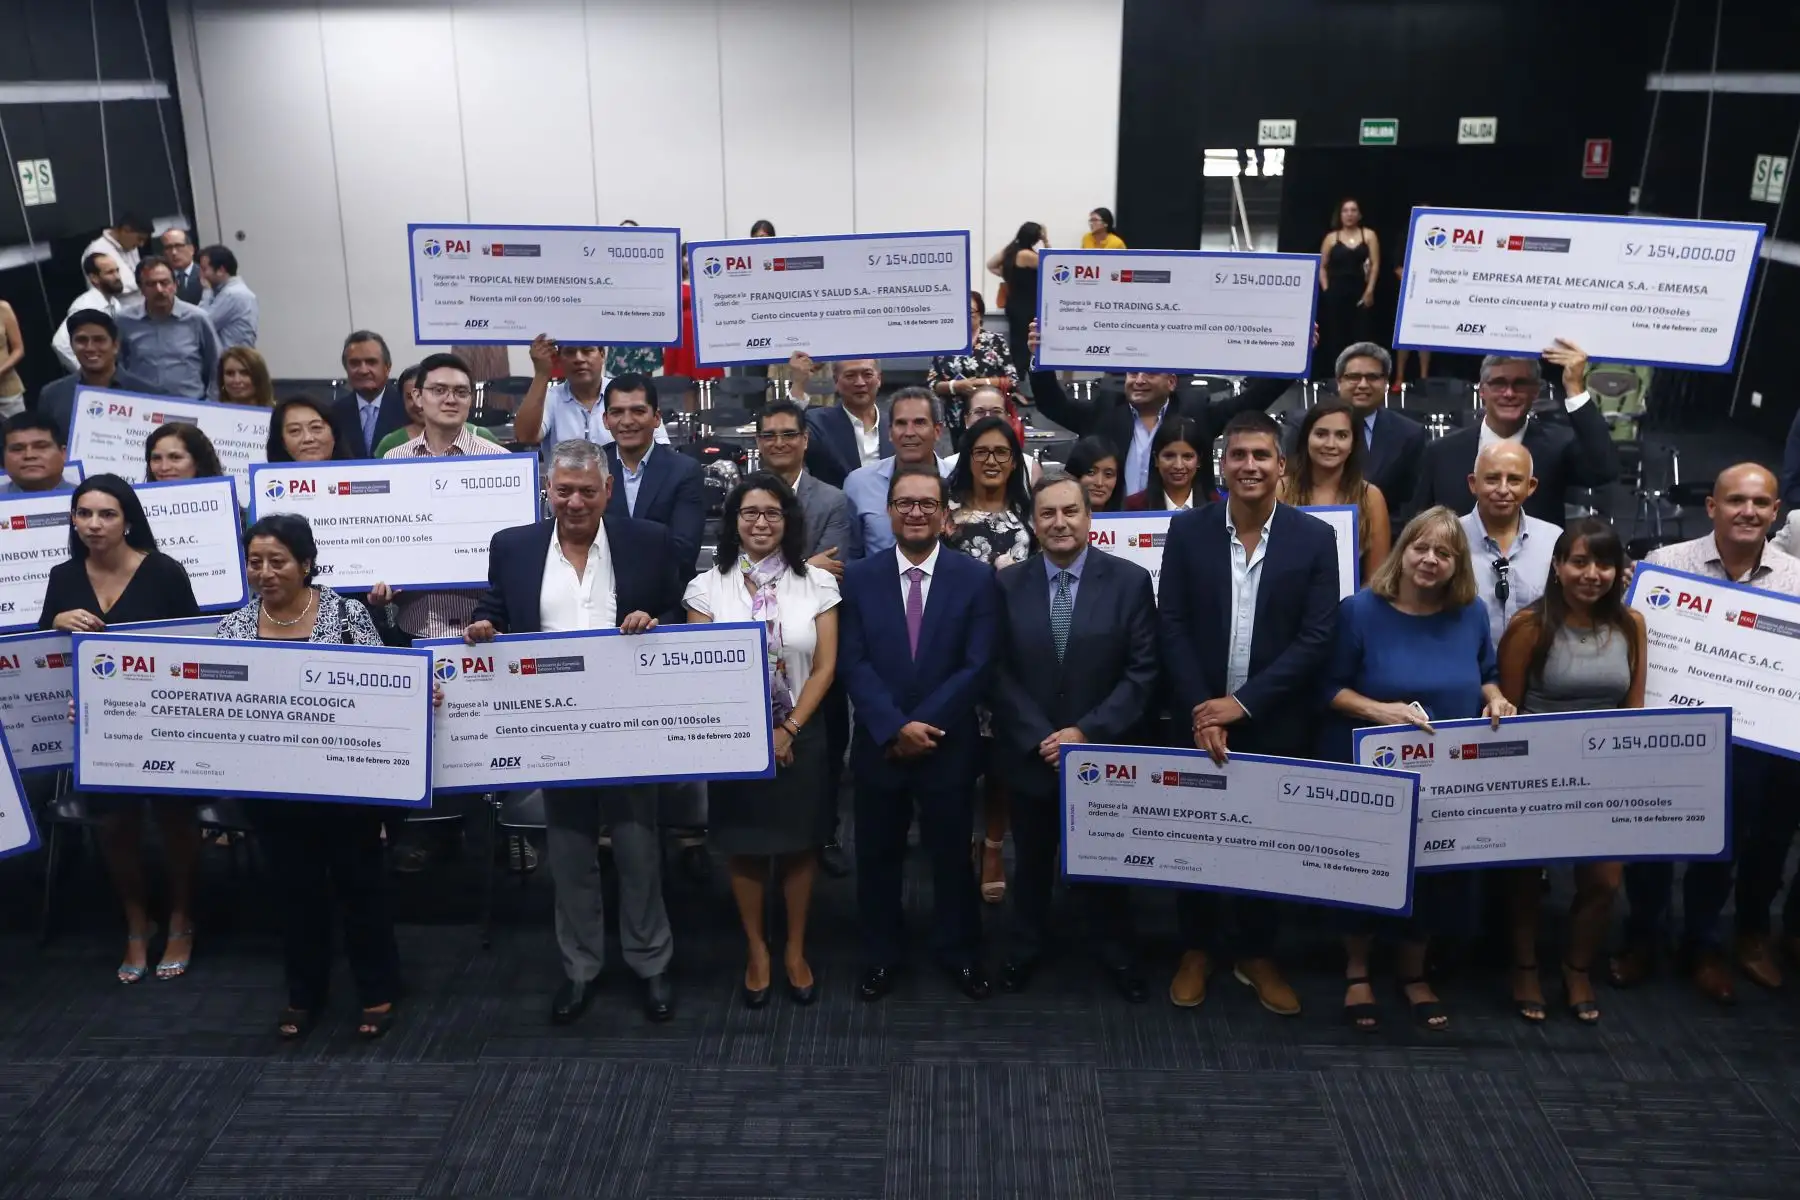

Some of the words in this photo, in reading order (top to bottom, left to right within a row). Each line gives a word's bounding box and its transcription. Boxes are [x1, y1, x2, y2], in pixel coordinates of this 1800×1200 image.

[1262, 125, 1291, 139] SALIDA
[1462, 123, 1492, 138] SALIDA
[39, 163, 50, 186] S
[1452, 228, 1484, 245] PAI
[445, 240, 471, 253] PAI
[583, 246, 596, 257] S/
[1625, 243, 1643, 256] S/
[726, 256, 752, 270] PAI
[868, 255, 881, 266] S/
[1075, 266, 1100, 279] PAI
[1215, 273, 1228, 284] S/
[469, 275, 512, 284] TROPICAL
[514, 276, 535, 284] NEW
[536, 277, 587, 285] DIMENSION
[588, 277, 613, 286] S.A.C.
[1472, 272, 1523, 284] EMPRESA
[1525, 274, 1562, 286] METAL
[1564, 276, 1624, 289] MECANICA
[1628, 281, 1648, 291] S.A.
[1657, 283, 1708, 295] EMEMSA
[750, 290, 812, 301] FRANQUICIAS
[813, 289, 820, 298] Y
[821, 288, 852, 297] SALUD
[853, 287, 871, 296] S.A.
[877, 284, 932, 295] FRANSALUD
[934, 284, 951, 293] S.A.
[1094, 301, 1112, 310] FLO
[1113, 302, 1154, 311] TRADING
[1155, 302, 1181, 311] S.A.C.
[1468, 294, 1499, 304] Ciento
[1501, 296, 1549, 307] cincuenta
[1550, 301, 1556, 309] y
[1558, 301, 1590, 310] cuatro
[1591, 302, 1608, 311] mil
[1610, 304, 1628, 313] con
[465, 319, 490, 328] ADEX
[1456, 323, 1486, 334] ADEX
[746, 338, 771, 347] ADEX
[1086, 345, 1110, 354] ADEX
[108, 404, 133, 417] PAI
[289, 479, 316, 493] PAI
[435, 479, 448, 490] S/
[313, 516, 337, 526] NIKO
[339, 514, 413, 525] INTERNATIONAL
[415, 513, 433, 523] SAC
[315, 537, 349, 546] Noventa
[350, 536, 365, 545] mil
[382, 535, 411, 544] 00/100
[412, 534, 433, 542] soles
[1088, 531, 1115, 545] PAI
[316, 565, 335, 574] DEX
[1676, 591, 1713, 614] PAI
[640, 653, 656, 667] S/
[1694, 641, 1748, 663] BLAMAC
[1748, 654, 1784, 672] S.A.C.
[121, 655, 155, 673] PAI
[461, 656, 494, 673] PAI
[305, 669, 322, 684] S/
[1687, 665, 1733, 684] Noventa
[1735, 677, 1754, 689] mil
[1755, 683, 1775, 695] con
[151, 689, 232, 702] COOPERATIVA
[235, 693, 287, 705] AGRARIA
[290, 695, 356, 708] ECOLOGICA
[493, 699, 542, 711] UNILENE
[544, 697, 577, 708] S.A.C.
[31, 713, 65, 723] Ciento
[103, 708, 125, 716] orden
[151, 704, 224, 718] CAFETALERA
[227, 708, 243, 718] DE
[246, 709, 284, 720] LONYA
[286, 711, 336, 723] GRANDE
[495, 724, 528, 735] Ciento
[530, 722, 579, 733] cincuenta
[581, 723, 587, 732] y
[589, 720, 621, 730] cuatro
[623, 718, 639, 728] mil
[641, 718, 659, 727] con
[661, 714, 721, 726] 00/100soles
[114, 733, 133, 741] suma
[134, 733, 143, 741] de
[151, 728, 185, 738] Ciento
[187, 729, 238, 740] cincuenta
[239, 733, 245, 743] y
[247, 733, 281, 743] cuatro
[282, 734, 299, 744] mil
[301, 736, 319, 745] con
[321, 736, 382, 748] 00/100soles
[667, 733, 686, 742] Lima,
[687, 733, 696, 741] 18
[706, 732, 731, 740] febrero
[733, 731, 751, 739] 2020
[31, 741, 62, 753] ADEX
[1588, 737, 1605, 750] S/
[1401, 742, 1434, 760] PAI
[142, 759, 176, 771] ADEX
[326, 755, 345, 763] Lima,
[346, 755, 355, 763] 18
[355, 756, 365, 764] de
[365, 756, 391, 765] febrero
[393, 758, 410, 766] 2020
[490, 756, 522, 768] ADEX
[1105, 764, 1137, 780] PAI
[1283, 783, 1300, 796] S/
[1430, 782, 1484, 795] TRADING
[1486, 778, 1549, 792] VENTURES
[1551, 777, 1591, 788] E.I.R.L.
[1132, 805, 1171, 817] ANAWI
[1173, 808, 1218, 821] EXPORT
[1219, 812, 1252, 824] S.A.C.
[1431, 808, 1465, 819] Ciento
[1467, 806, 1518, 817] cincuenta
[1519, 806, 1526, 815] y
[1528, 801, 1563, 812] cuatro
[1564, 800, 1582, 810] mil
[1584, 800, 1604, 809] con
[1132, 827, 1164, 838] Ciento
[1166, 829, 1215, 842] cincuenta
[1216, 835, 1223, 844] y
[1224, 835, 1257, 847] cuatro
[1259, 839, 1275, 849] mil
[1277, 842, 1295, 851] con
[1298, 843, 1360, 859] 00/100soles
[1423, 839, 1456, 851] ADEX
[1124, 854, 1155, 865] ADEX
